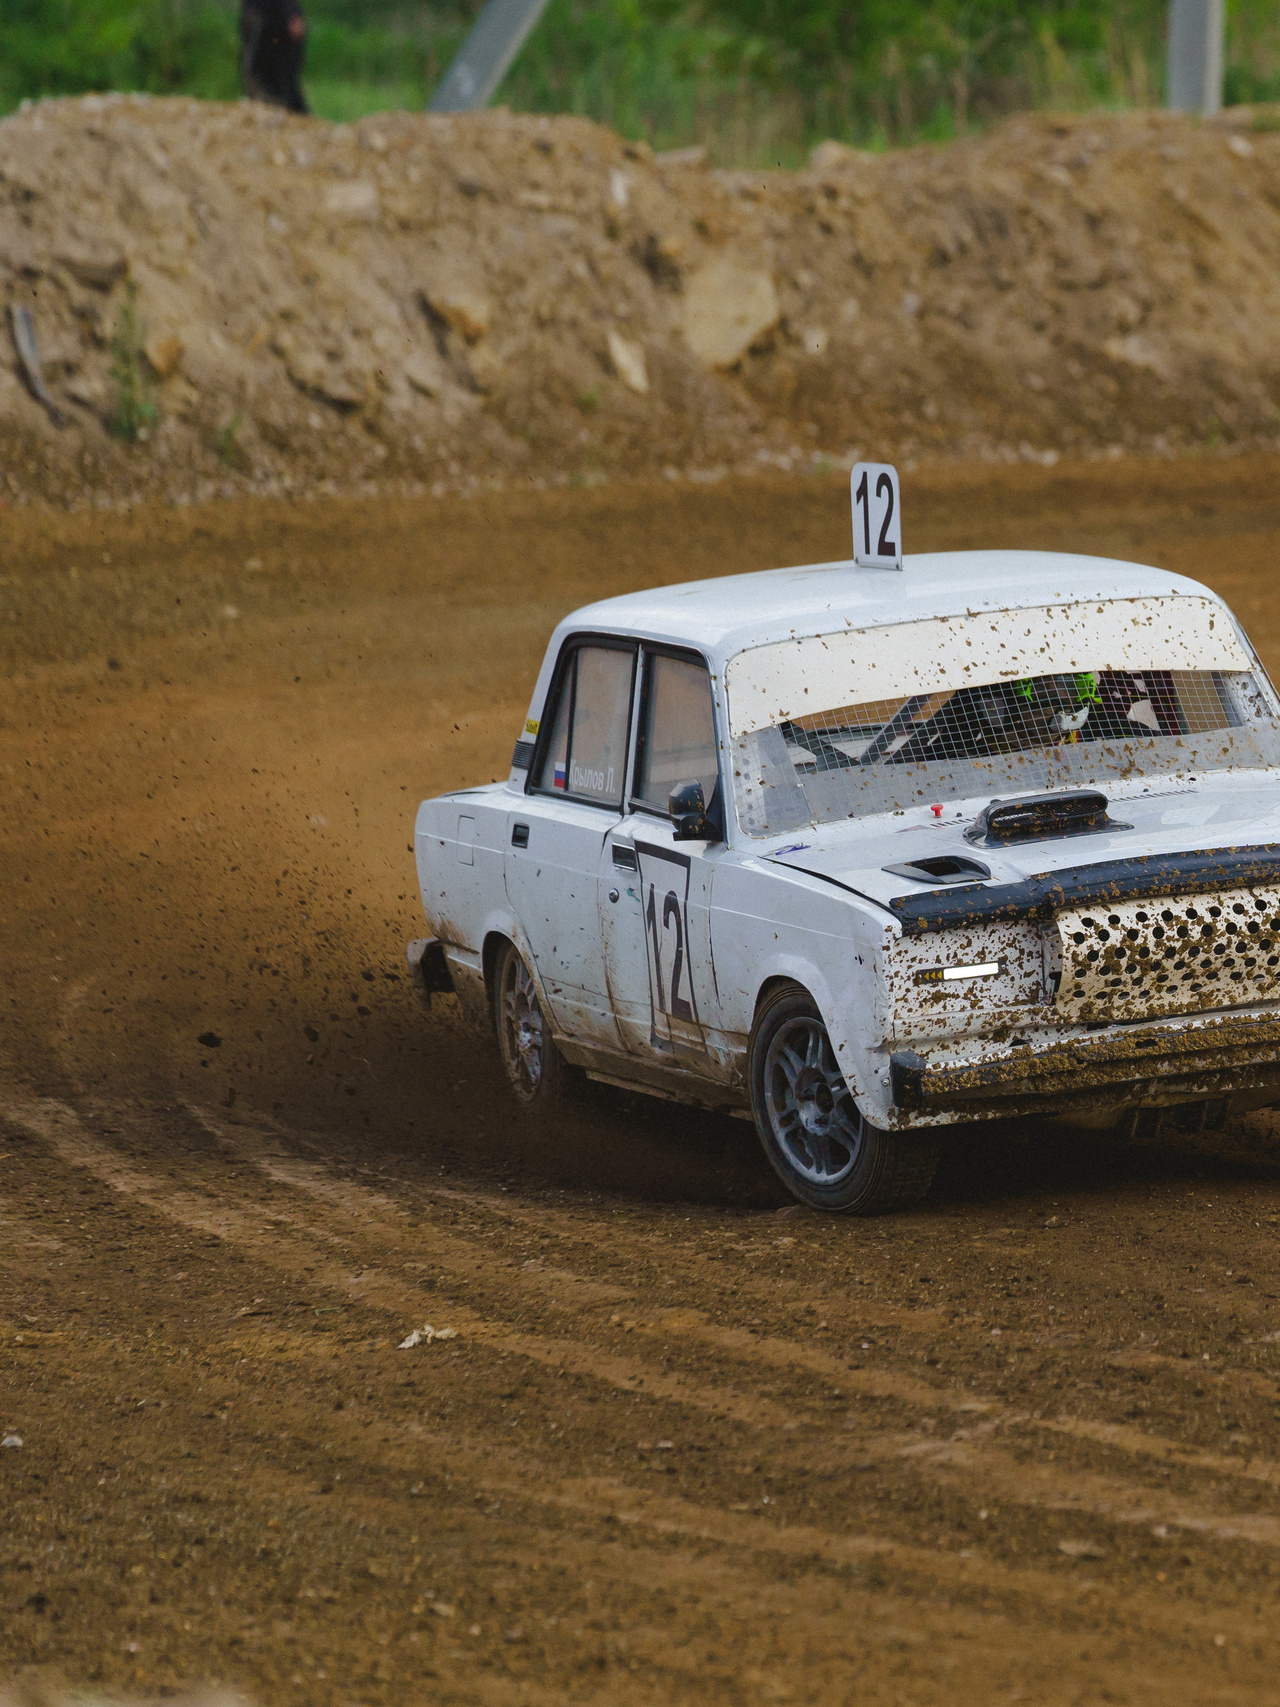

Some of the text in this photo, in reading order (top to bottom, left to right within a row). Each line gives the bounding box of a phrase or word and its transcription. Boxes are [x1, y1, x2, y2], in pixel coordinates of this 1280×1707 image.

[856, 471, 896, 557] 12
[569, 758, 616, 794] Крылов Л.
[646, 882, 695, 1023] 12
